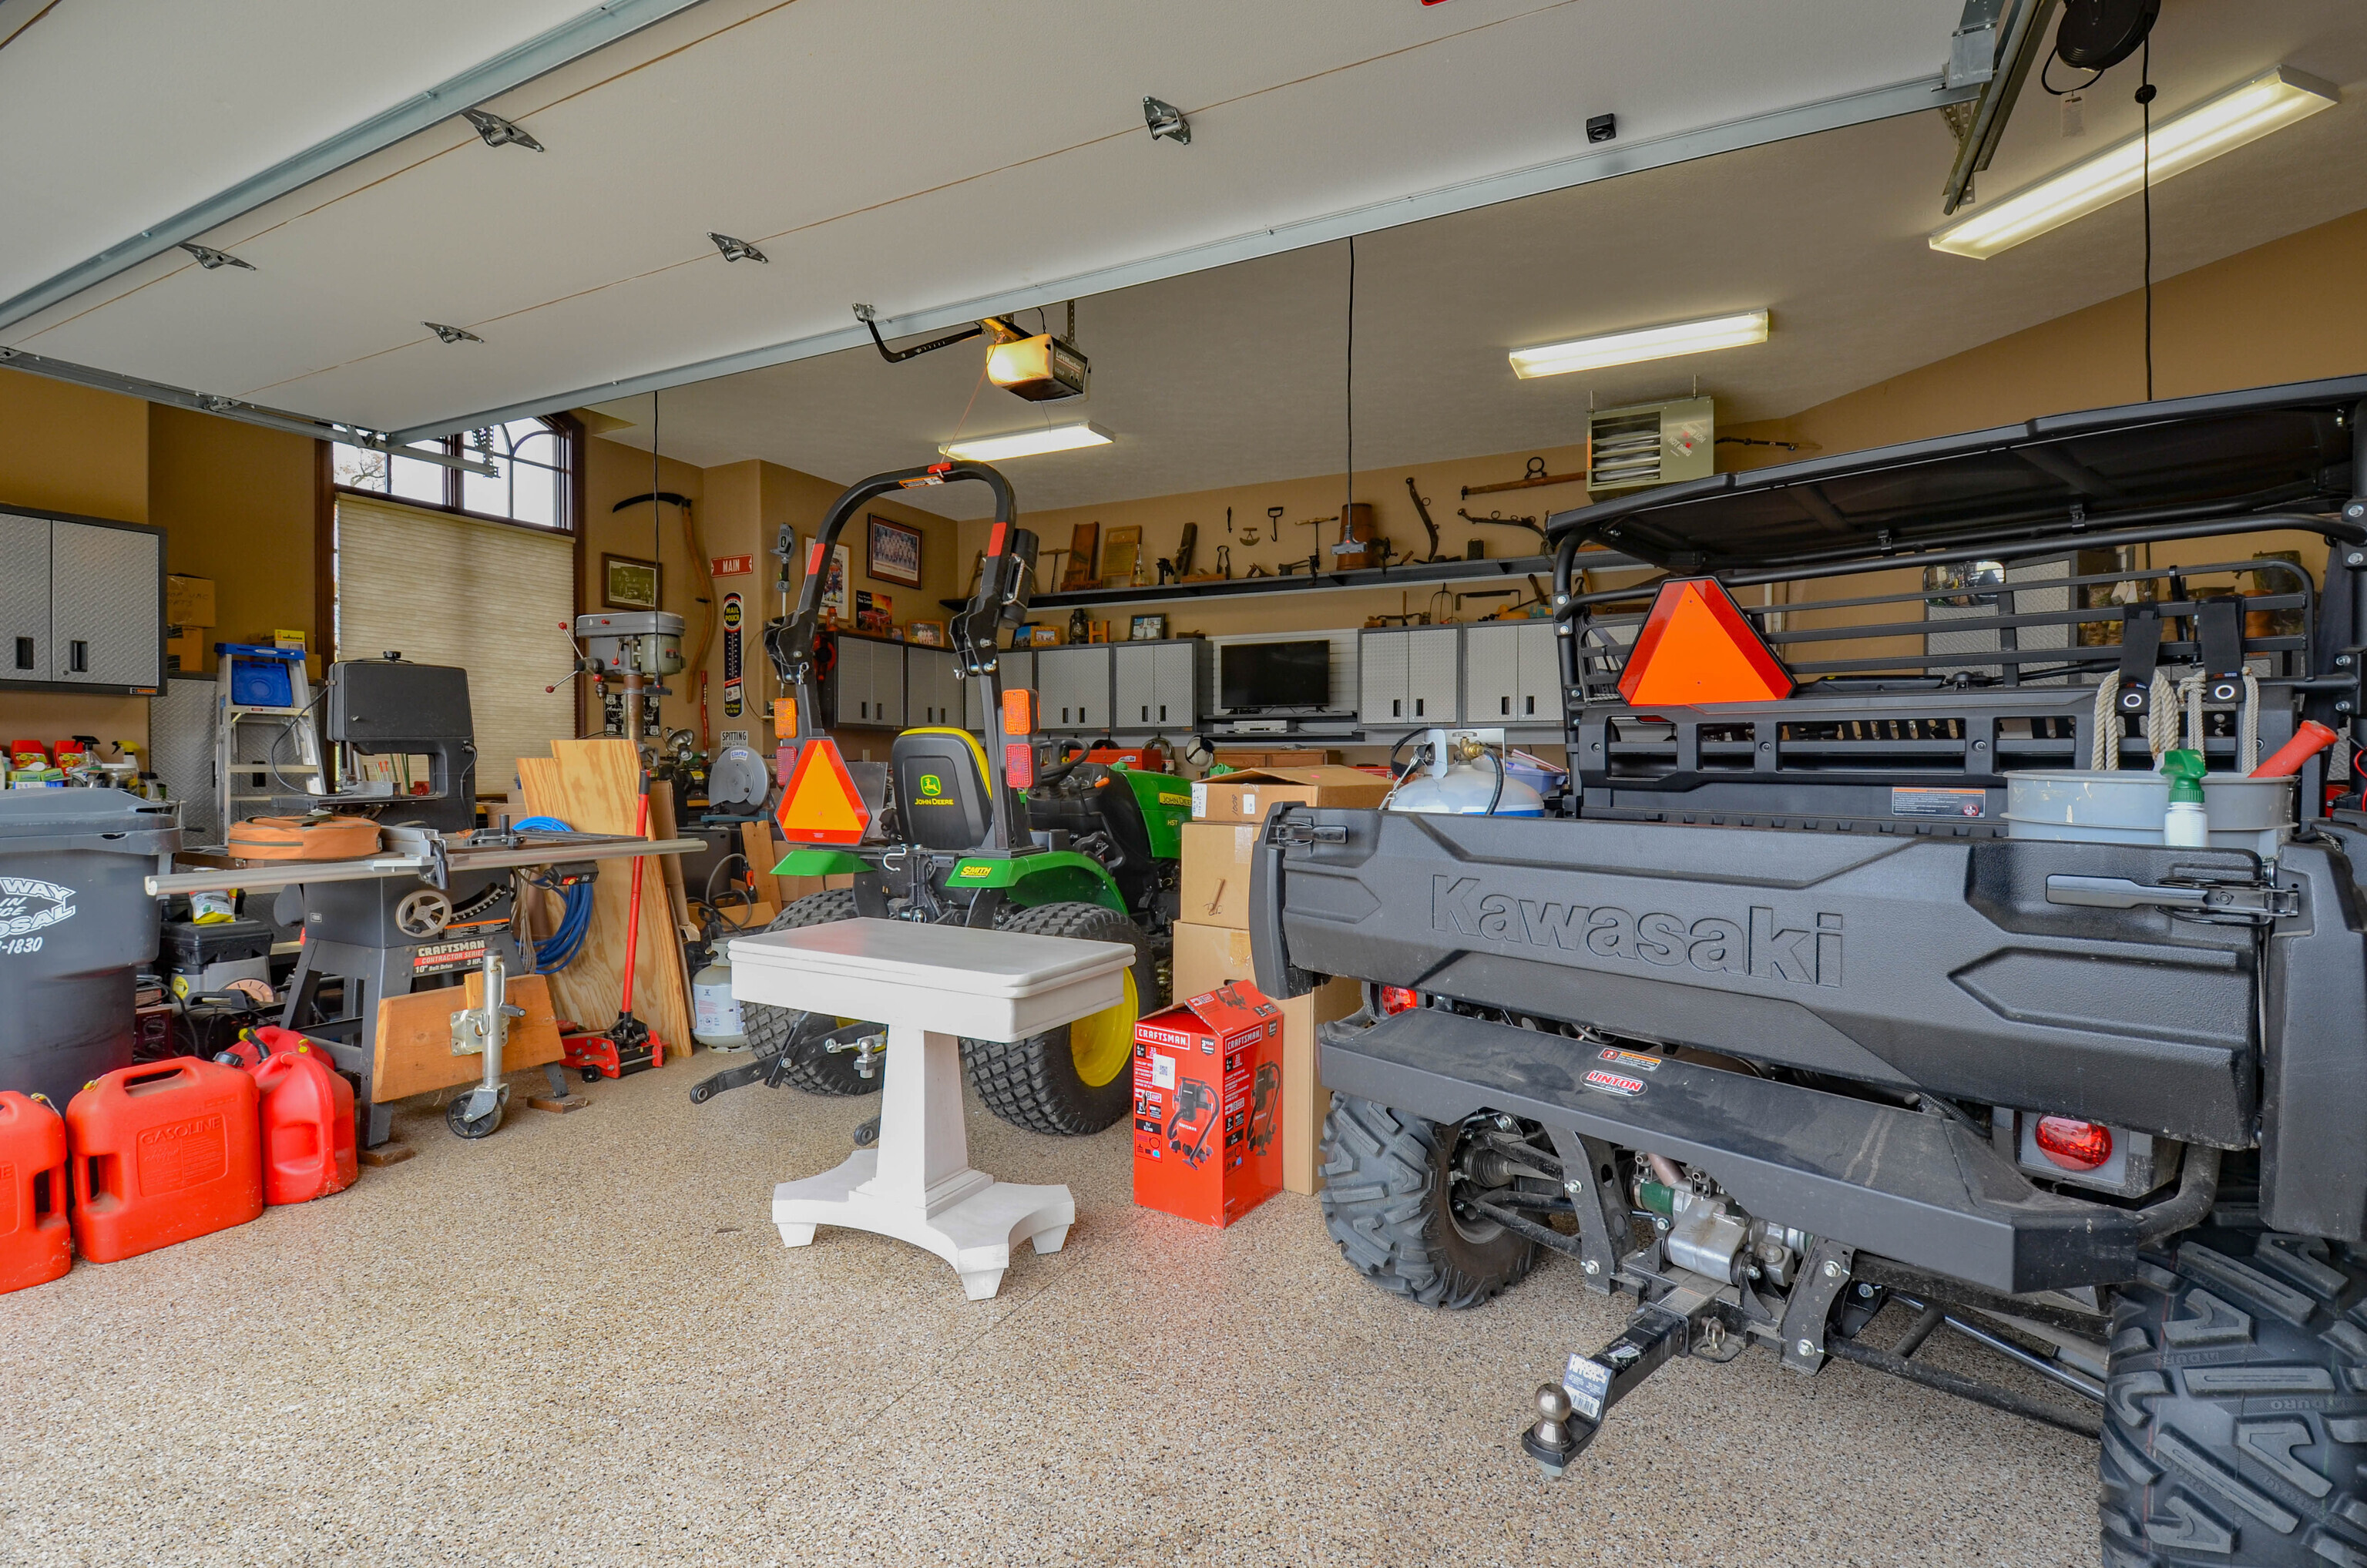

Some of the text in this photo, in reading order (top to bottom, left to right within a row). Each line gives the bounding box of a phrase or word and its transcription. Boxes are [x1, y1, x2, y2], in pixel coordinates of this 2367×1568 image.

[723, 559, 740, 572] MAIN
[722, 731, 747, 741] SPITTING
[1162, 796, 1192, 807] JOHN DEE
[961, 866, 992, 876] SMITH
[2, 878, 76, 903] WAY
[0, 906, 27, 917] CE
[1432, 874, 1843, 989] Kawasaki
[0, 936, 43, 955] -1830
[418, 940, 485, 957] CRAFTSMAN
[421, 949, 485, 964] CONTRACTOR SERIES
[1138, 1029, 1187, 1046] CRAFTSMAN
[1227, 1028, 1261, 1050] CRAFTSMAN
[1586, 1071, 1643, 1092] LINTON
[140, 1116, 222, 1145] GASOLINE
